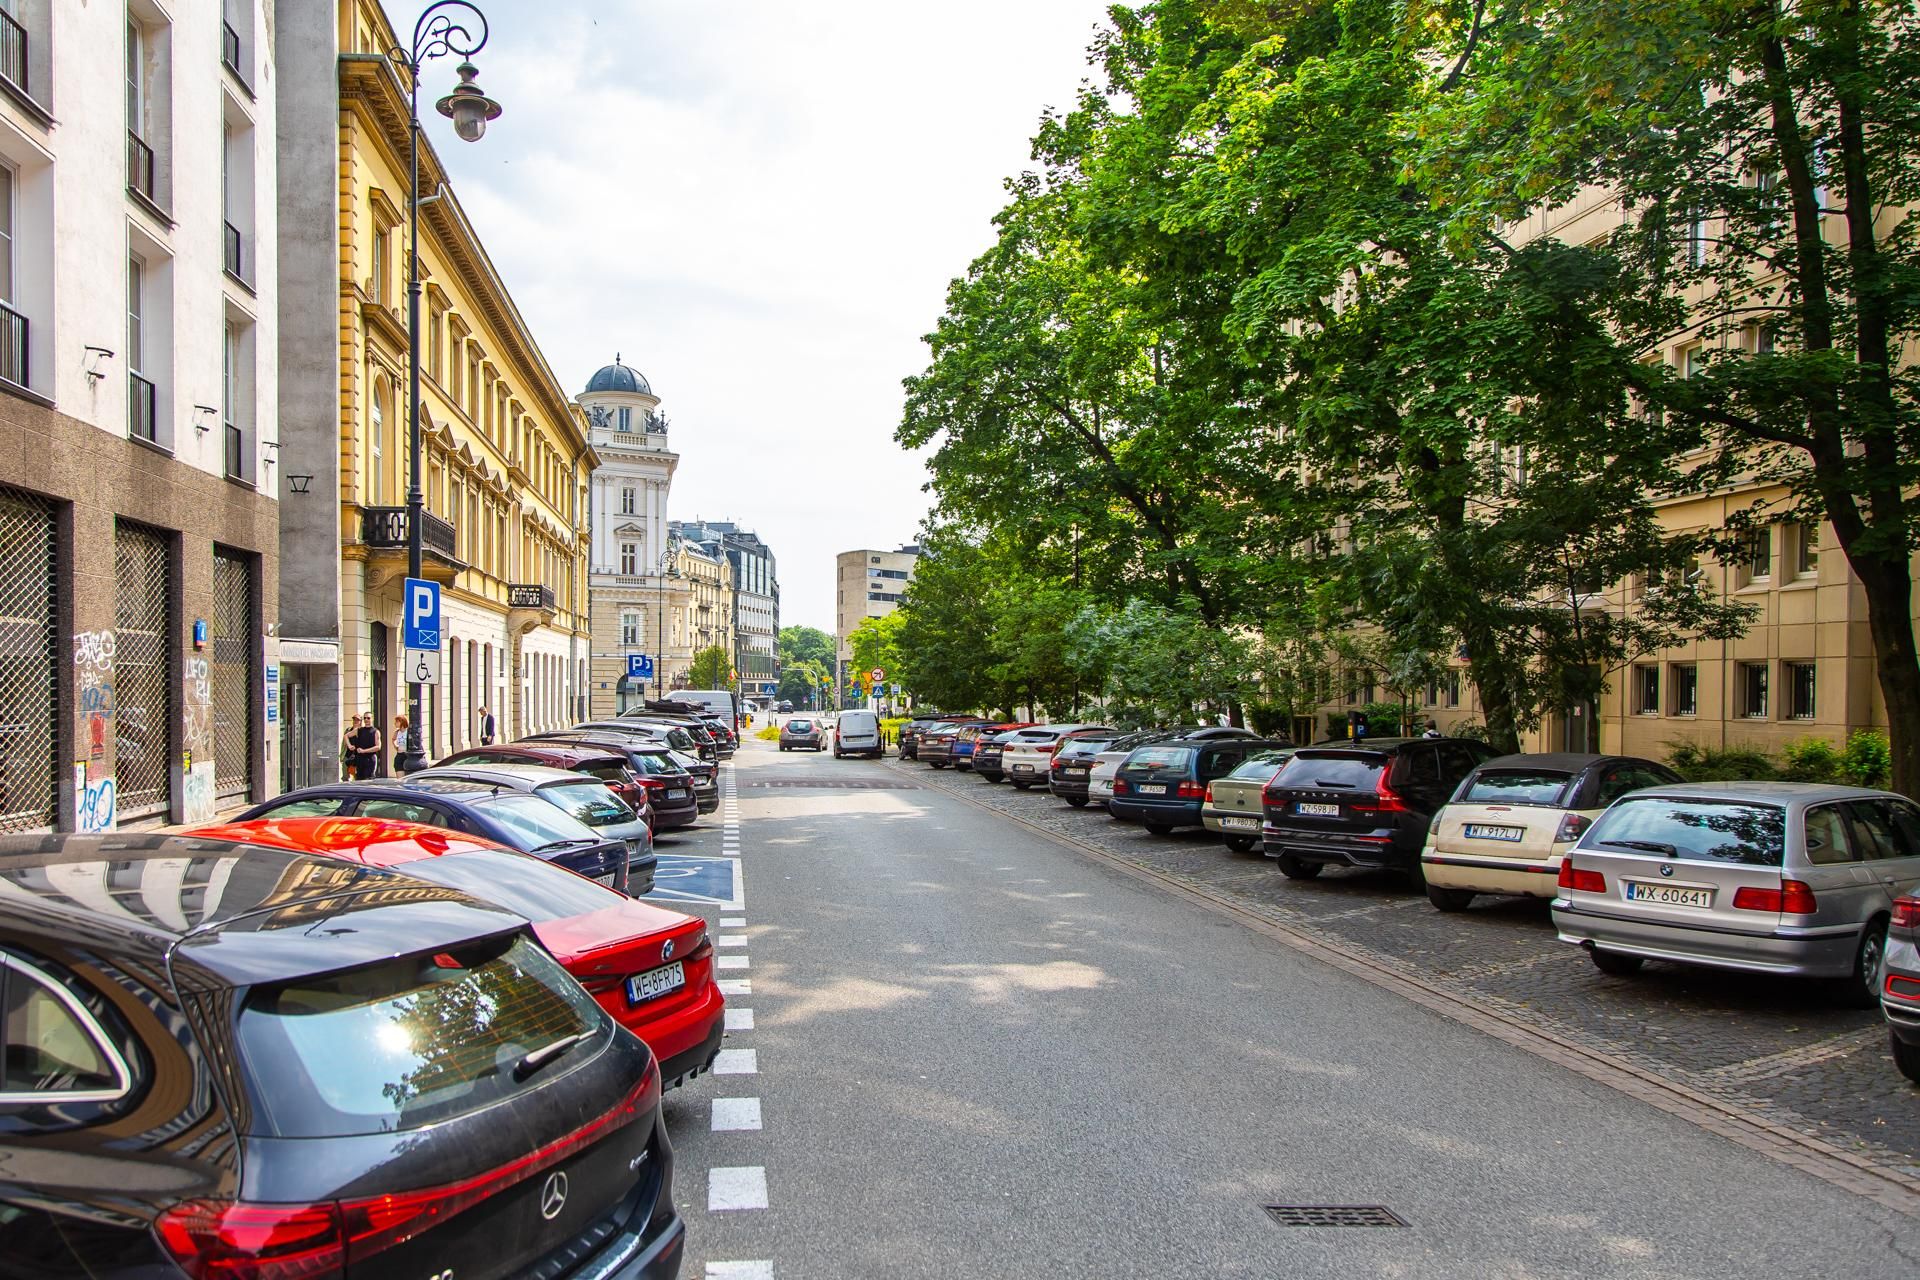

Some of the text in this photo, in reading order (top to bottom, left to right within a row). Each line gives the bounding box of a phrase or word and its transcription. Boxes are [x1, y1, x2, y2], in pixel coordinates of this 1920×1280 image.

[412, 586, 433, 628] P
[632, 656, 643, 671] P
[1357, 724, 1365, 734] P
[1301, 804, 1337, 815] WZ 598JP
[1226, 817, 1235, 826] WI
[1472, 826, 1518, 839] WI 917LJ
[1636, 885, 1707, 906] WX 60641
[633, 974, 650, 999] WE
[651, 963, 682, 992] 8FR75
